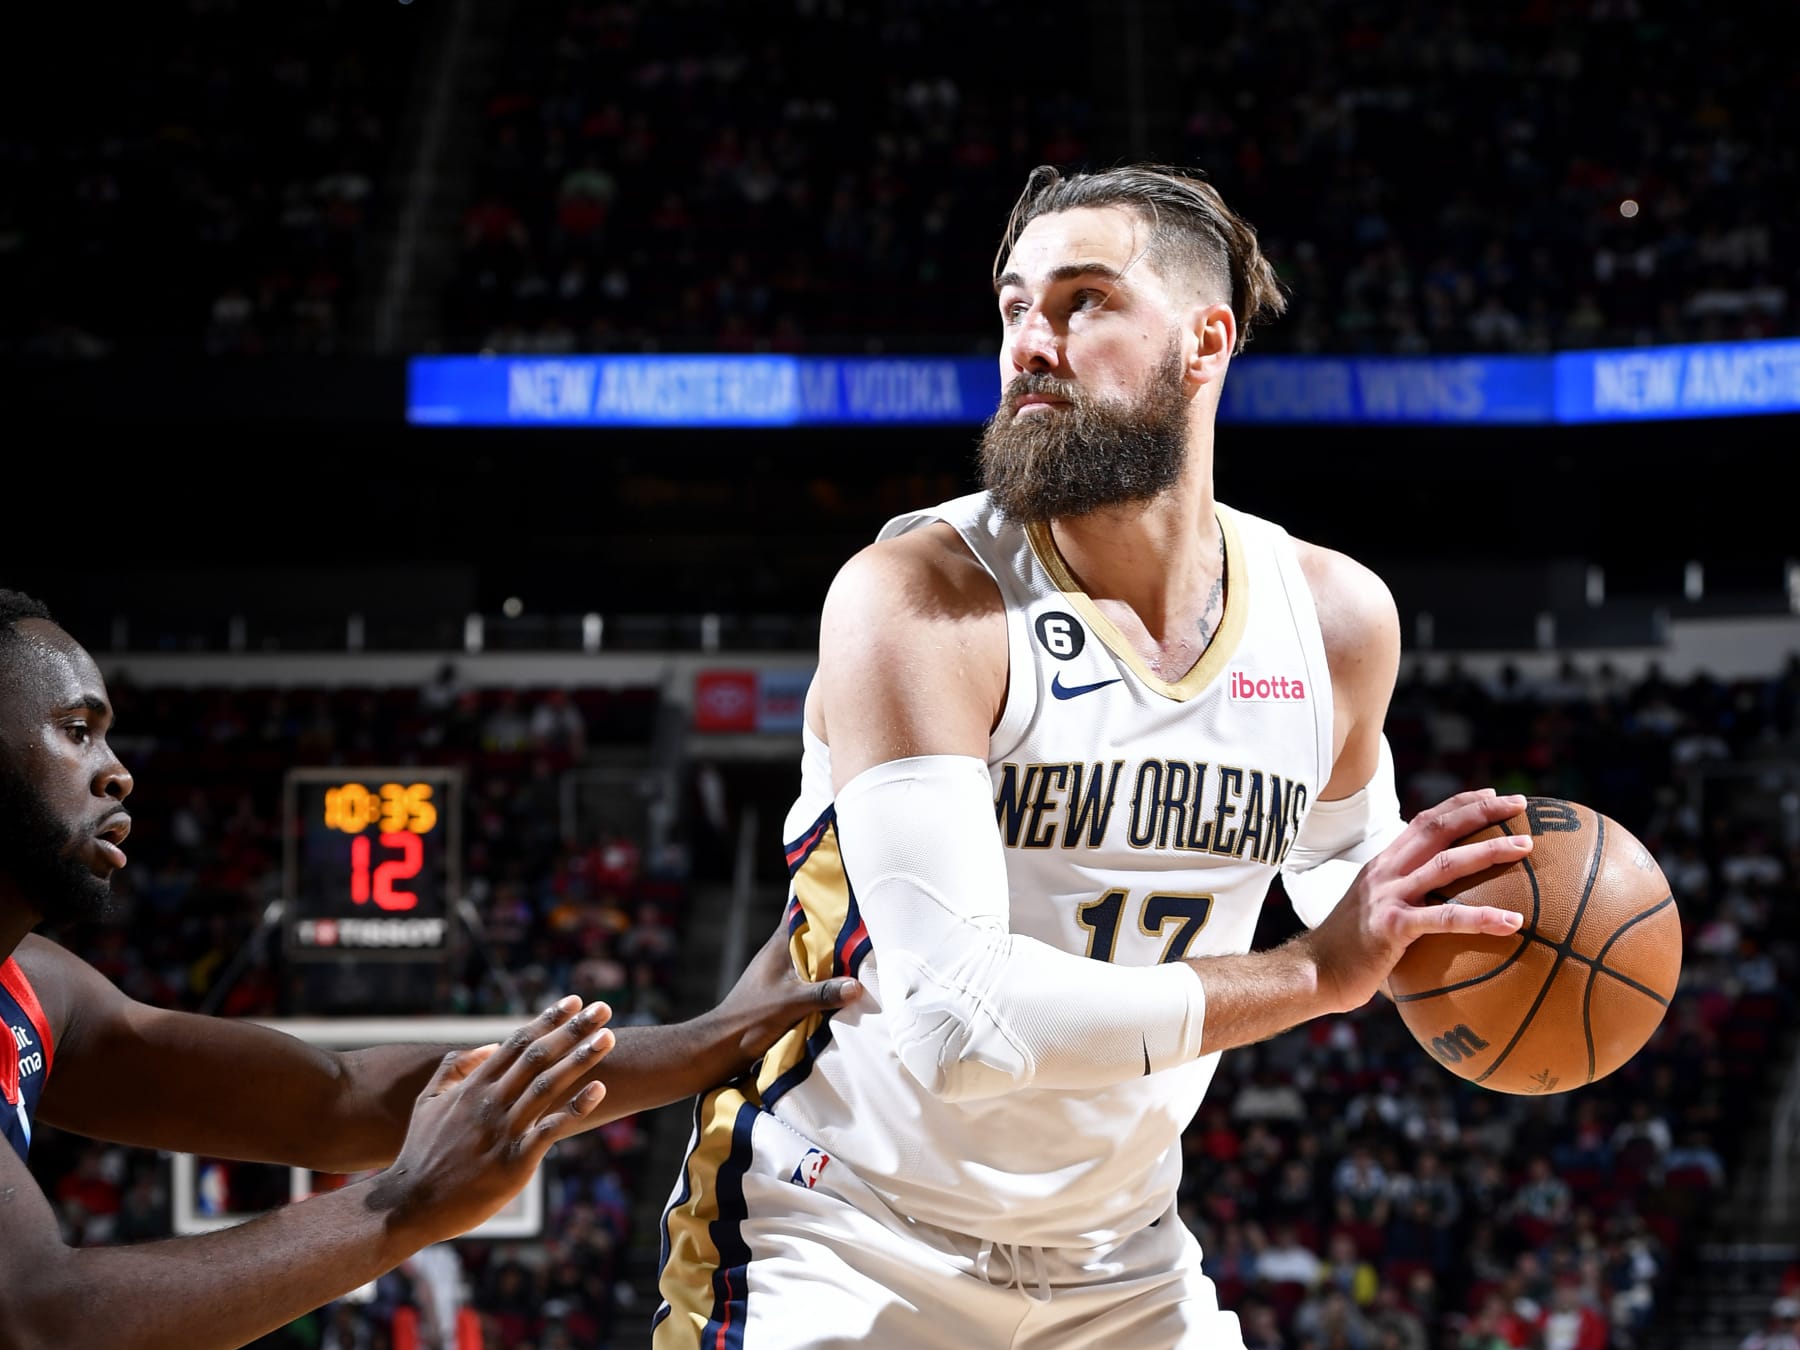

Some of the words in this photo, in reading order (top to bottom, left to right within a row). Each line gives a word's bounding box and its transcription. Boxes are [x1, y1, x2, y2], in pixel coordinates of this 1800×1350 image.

[508, 361, 595, 418] NEW
[1594, 354, 1681, 415] NEW
[1043, 618, 1073, 656] 6
[1231, 671, 1306, 700] ibotta
[324, 782, 438, 835] 10:35
[995, 759, 1126, 850] NEW
[1127, 757, 1308, 867] ORLEANS
[351, 830, 424, 912] 12
[1075, 887, 1215, 964] 17
